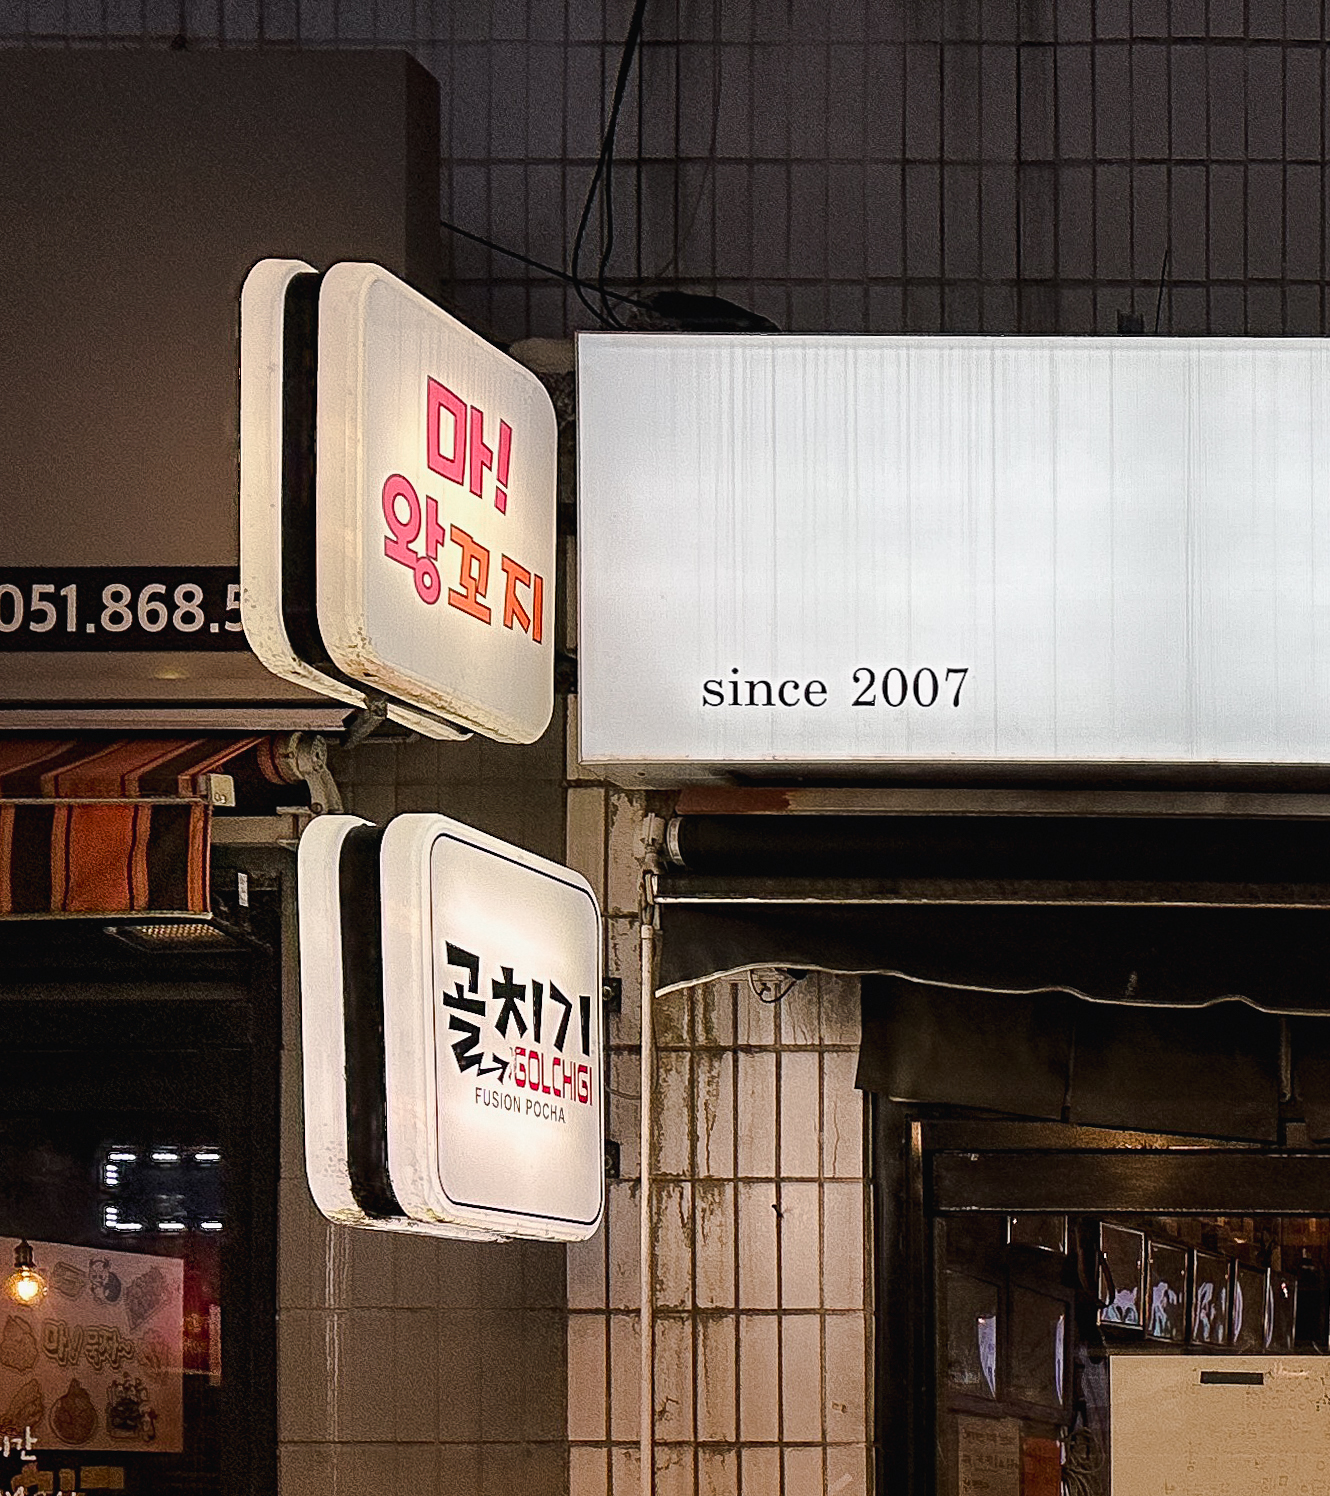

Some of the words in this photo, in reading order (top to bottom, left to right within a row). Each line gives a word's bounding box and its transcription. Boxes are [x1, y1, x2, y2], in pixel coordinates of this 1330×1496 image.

[426, 376, 513, 515] 마!
[382, 473, 543, 645] 왕꼬지
[701, 667, 828, 709] since
[851, 667, 970, 709] 2007
[443, 940, 591, 1084] 골치기
[475, 1087, 521, 1114] FUSION
[525, 1097, 566, 1124] POCHA
[509, 1045, 592, 1106] GOLCHIGI
